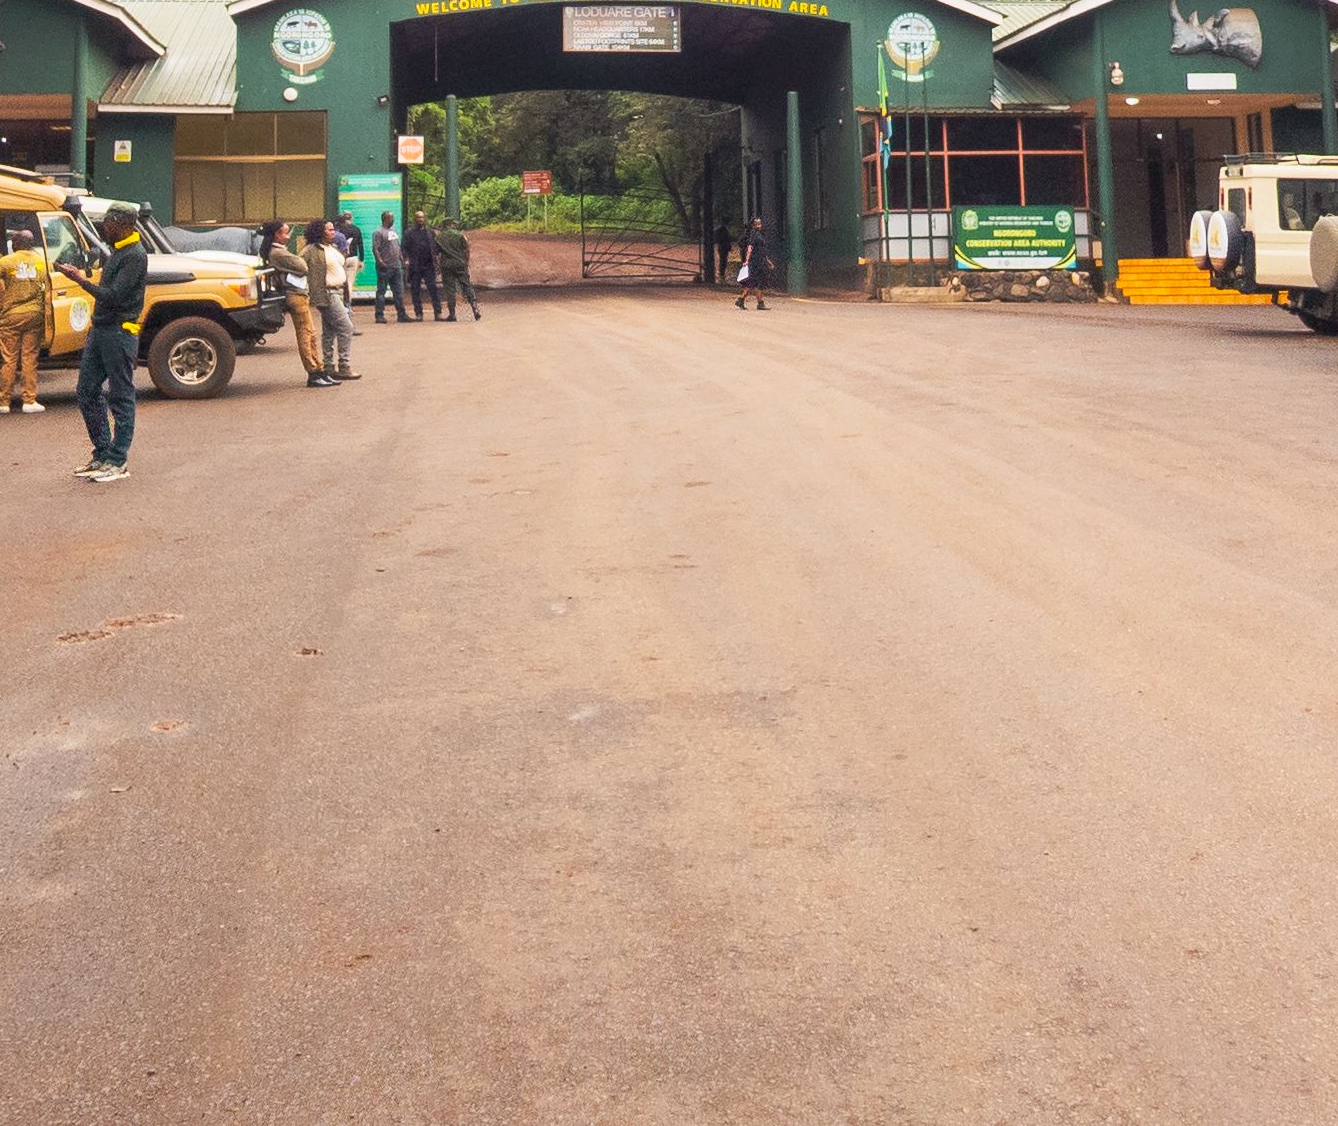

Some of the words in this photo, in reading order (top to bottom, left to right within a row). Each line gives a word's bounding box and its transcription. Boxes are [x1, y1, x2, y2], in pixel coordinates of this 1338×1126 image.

[574, 6, 631, 17] LODUARE
[634, 6, 666, 18] GATE
[788, 0, 829, 17] AREA
[401, 145, 422, 154] STOP
[965, 239, 1013, 248] CONSERVATION
[1013, 239, 1030, 247] AREA
[1031, 239, 1066, 247] AUTHORITY
